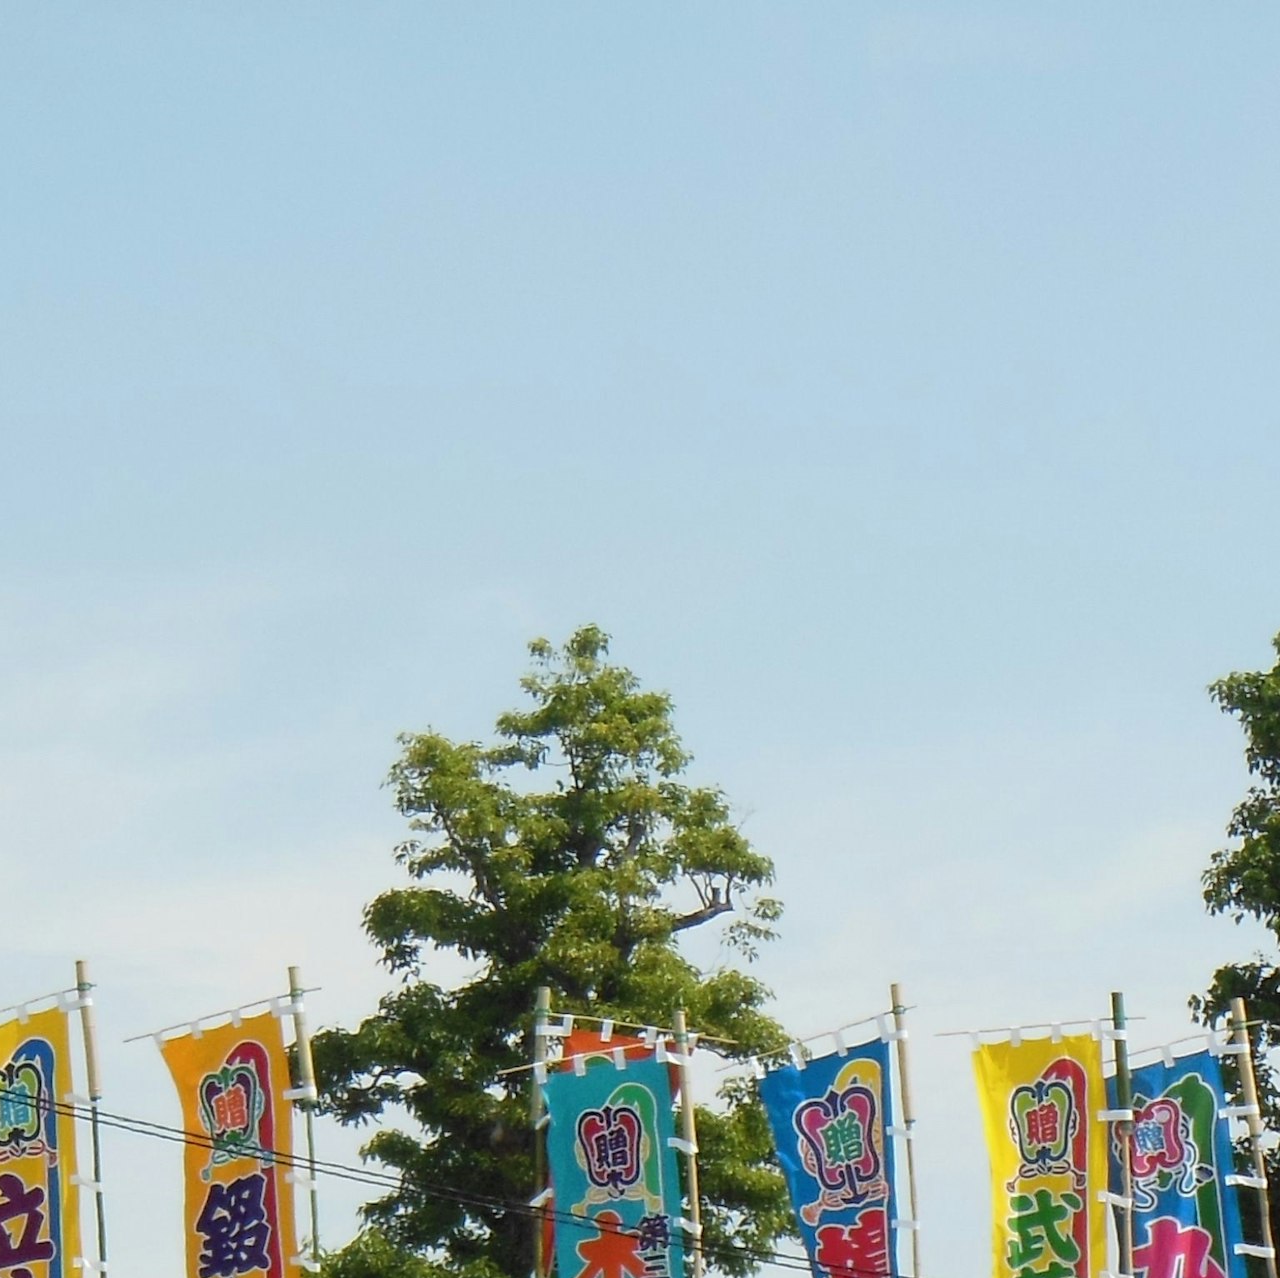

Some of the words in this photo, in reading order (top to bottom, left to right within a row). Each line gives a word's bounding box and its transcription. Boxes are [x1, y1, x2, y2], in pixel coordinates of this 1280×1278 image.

[214, 1094, 247, 1132] 贈
[1025, 1104, 1060, 1142] 贈
[595, 1126, 629, 1170] 贈
[820, 1113, 864, 1165] 贈
